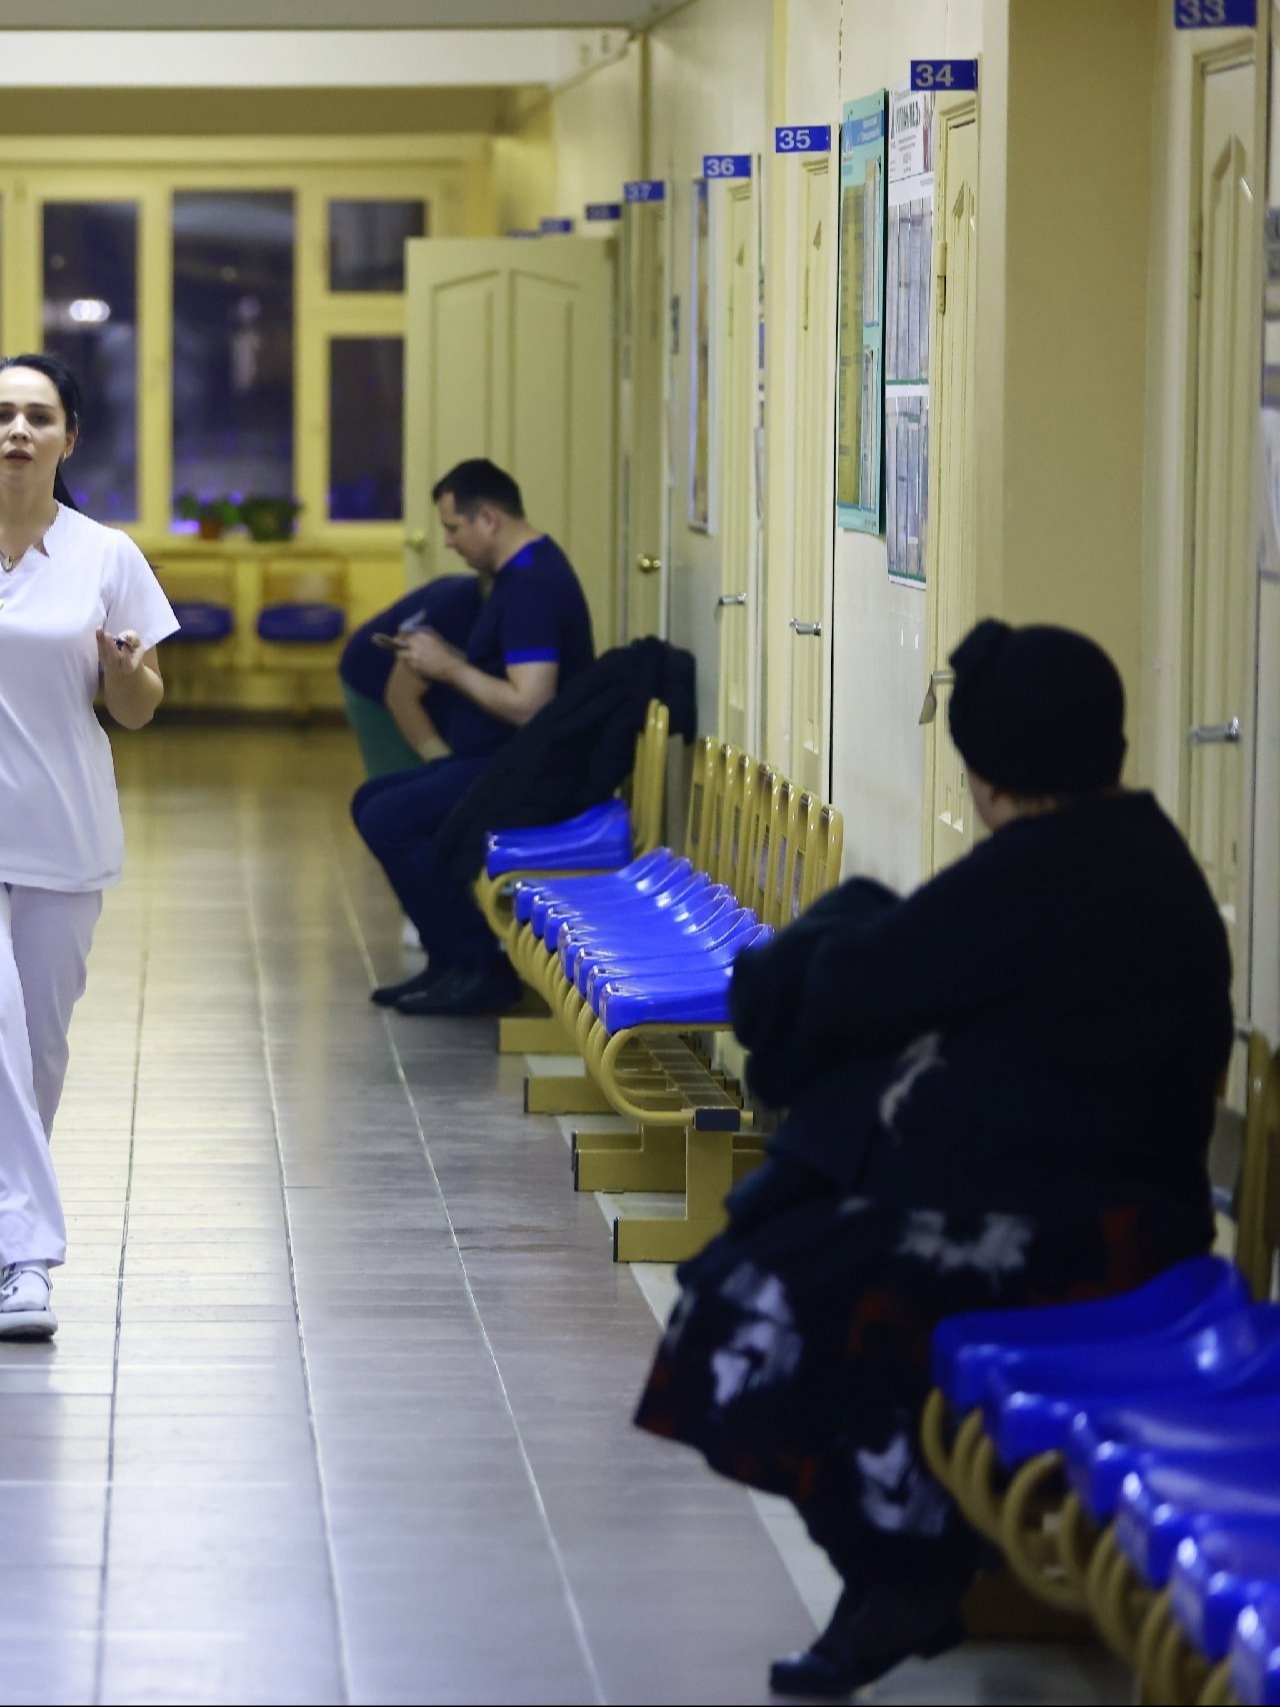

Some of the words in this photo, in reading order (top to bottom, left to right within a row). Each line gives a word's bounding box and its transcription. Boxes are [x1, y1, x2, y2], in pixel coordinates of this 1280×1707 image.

[915, 64, 954, 87] 34
[779, 129, 811, 149] 35
[706, 158, 735, 177] 36
[627, 184, 652, 200] 37
